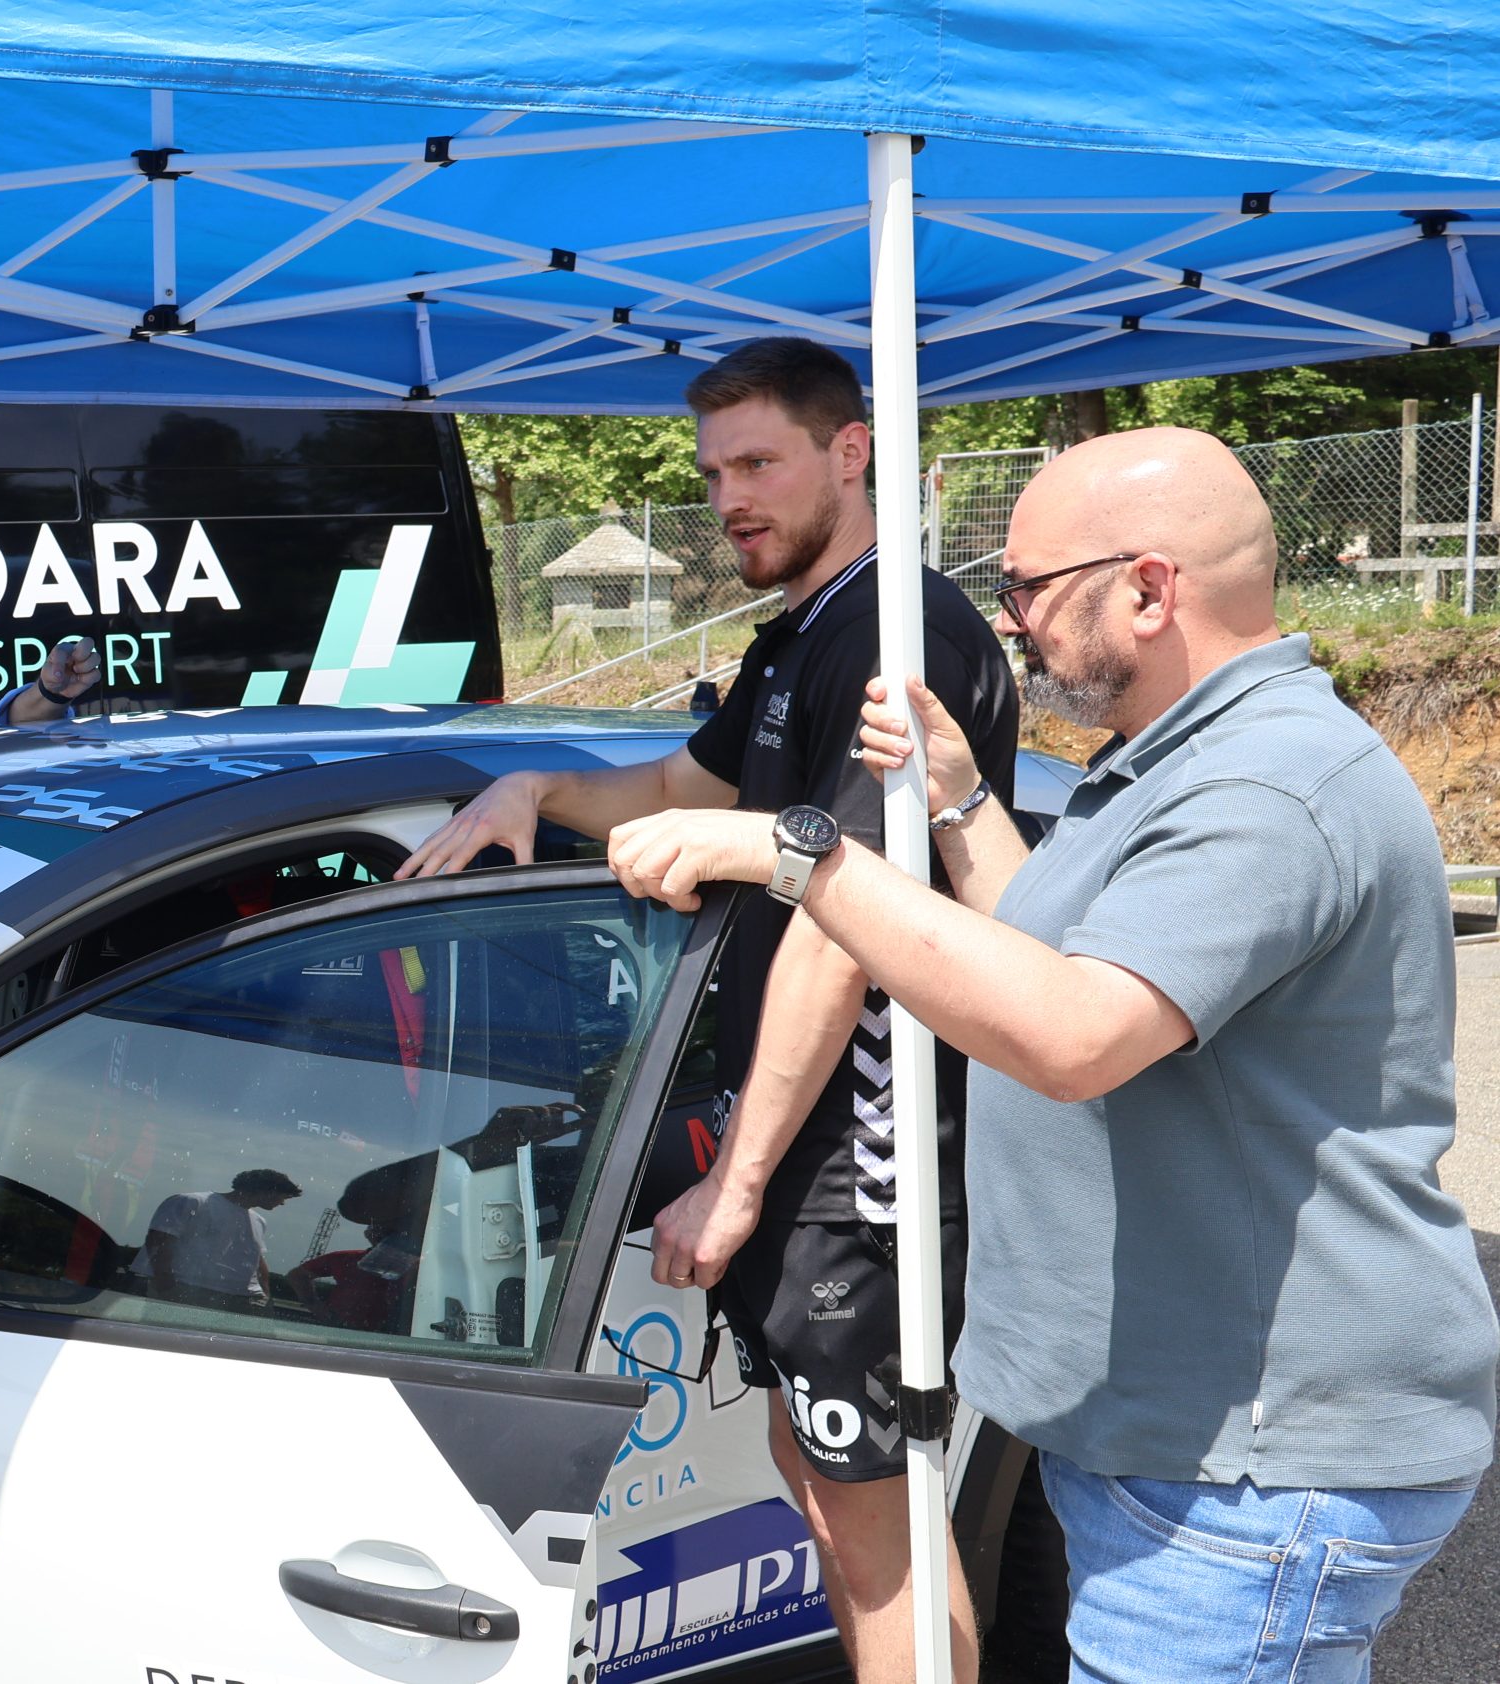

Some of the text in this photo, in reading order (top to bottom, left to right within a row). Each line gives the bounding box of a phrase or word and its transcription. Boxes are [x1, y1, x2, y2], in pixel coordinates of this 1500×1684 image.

[808, 1306, 856, 1321] hummel
[811, 1444, 850, 1463] GALICIA
[596, 1464, 697, 1520] NCIA
[742, 1540, 822, 1616] PT
[596, 1593, 827, 1677] feccionamiento y técnicas de con
[679, 1611, 730, 1634] ESCUELA
